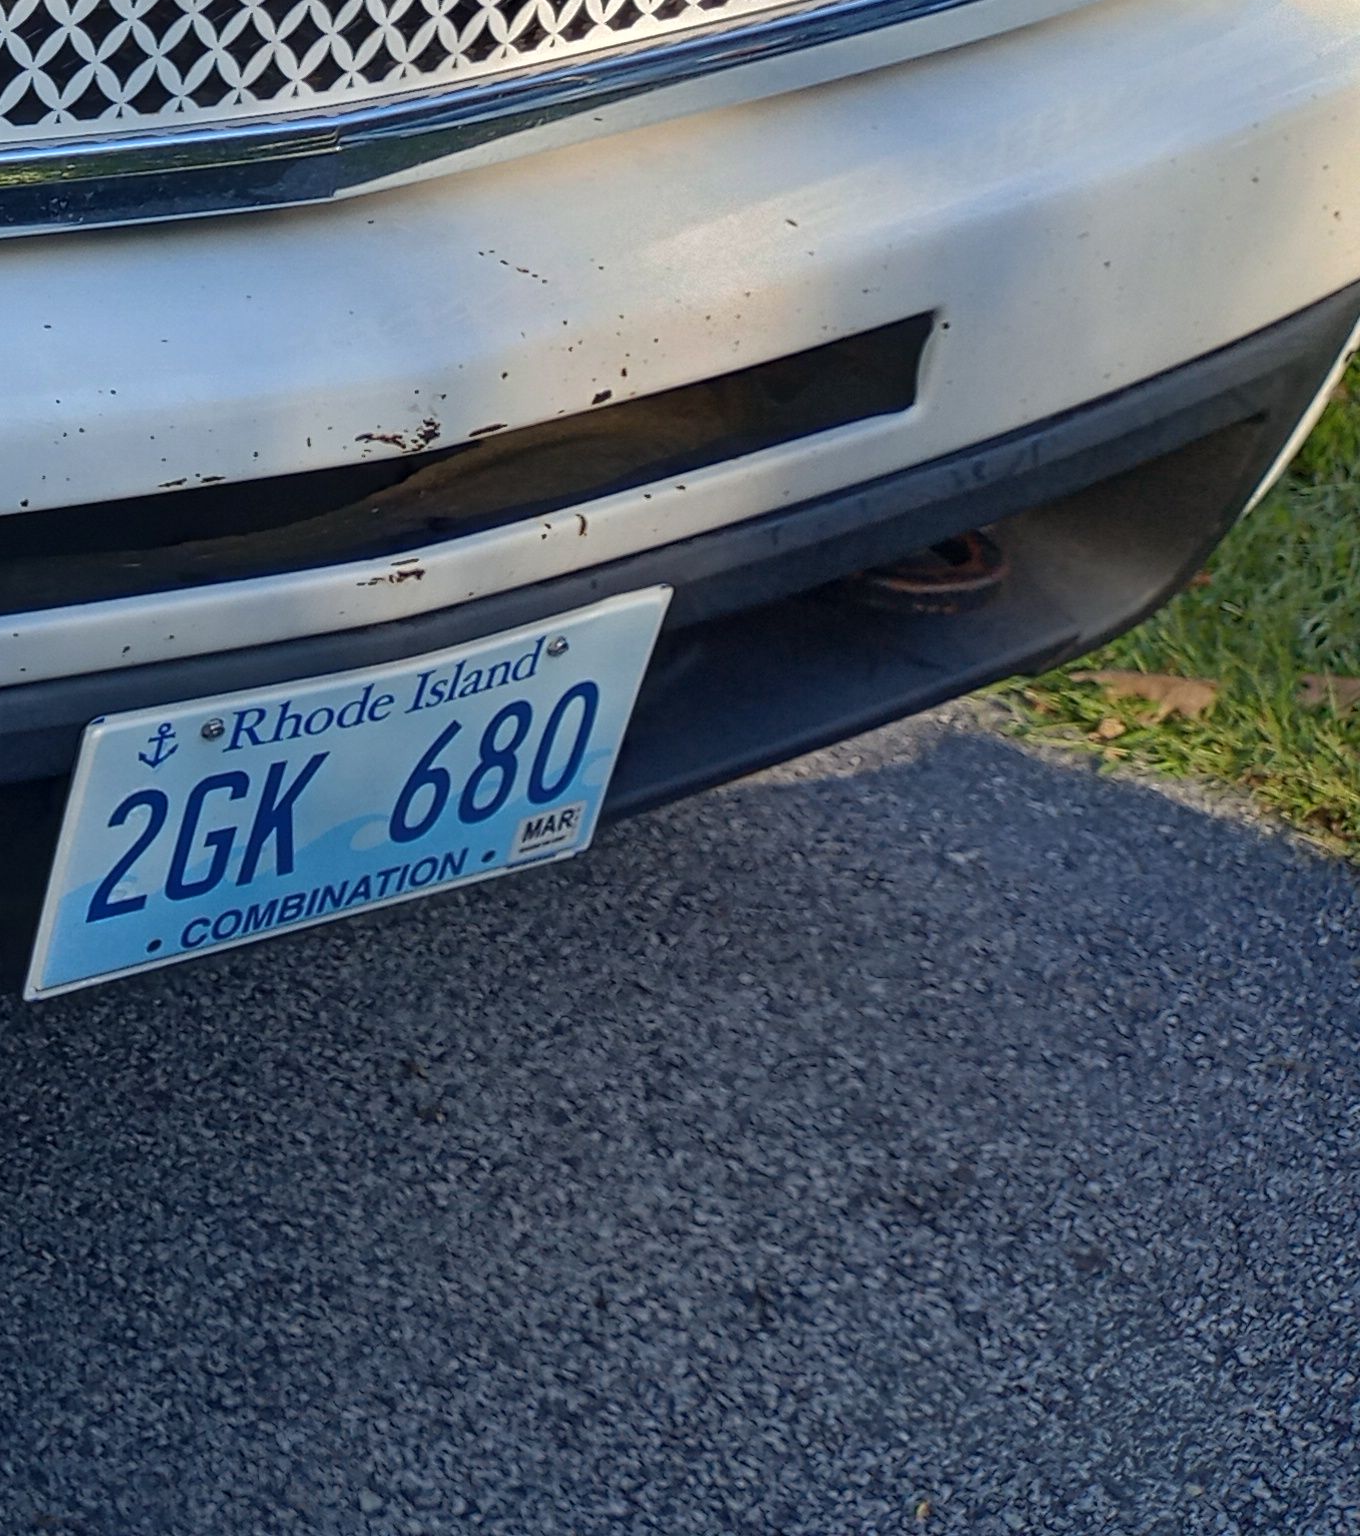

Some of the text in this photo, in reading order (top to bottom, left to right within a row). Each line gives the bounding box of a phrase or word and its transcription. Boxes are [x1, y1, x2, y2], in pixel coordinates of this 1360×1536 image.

[223, 637, 546, 752] Rhode Island
[86, 681, 600, 923] 2GK 680
[522, 809, 574, 843] MAR
[180, 848, 469, 949] COMBINATION
